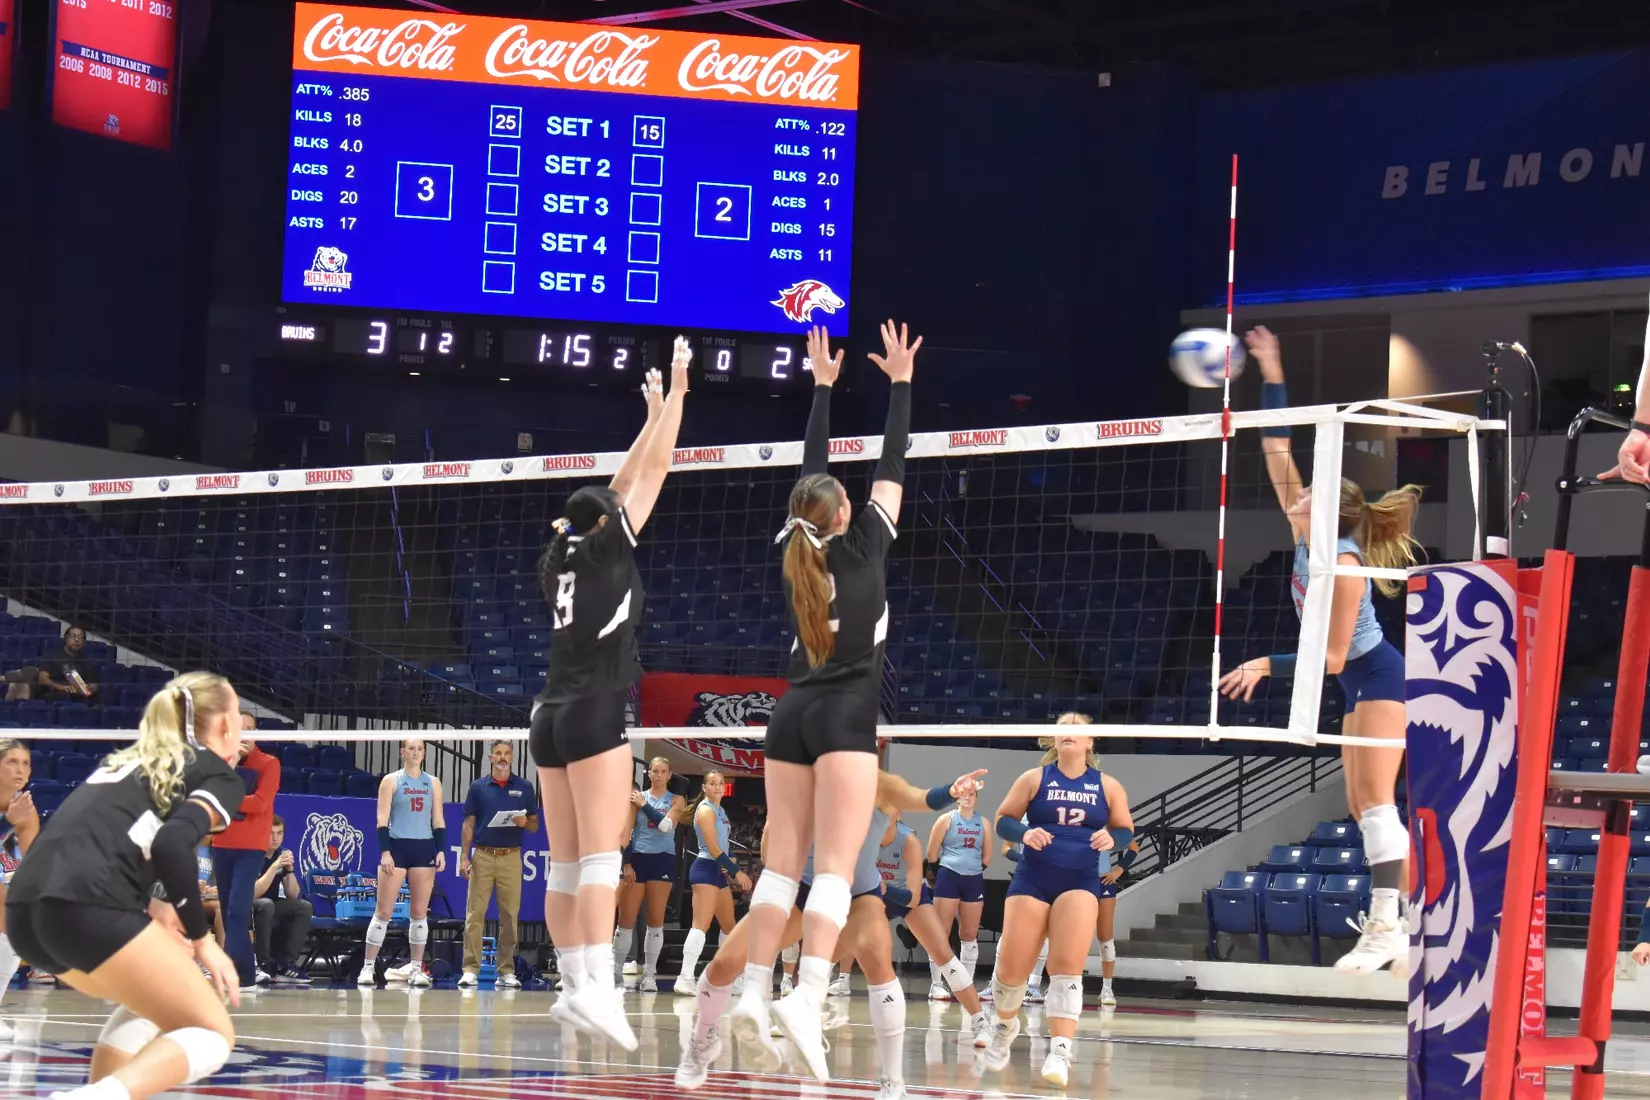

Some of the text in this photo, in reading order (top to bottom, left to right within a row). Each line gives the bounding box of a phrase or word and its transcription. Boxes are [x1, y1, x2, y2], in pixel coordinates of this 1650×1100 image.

[63, 0, 87, 9] 15
[149, 2, 173, 20] 2012
[303, 13, 466, 72] Coca-Cola
[80, 47, 152, 75] NCAA TOURNAMENT
[484, 24, 660, 88] Coca-Cola
[60, 55, 169, 96] 2006 2008 2012 2015
[677, 39, 850, 102] Coca-Cola
[296, 84, 369, 102] ATT% .385
[296, 110, 361, 126] KILLS 18
[496, 114, 516, 130] 25
[547, 116, 609, 138] SET 1
[641, 125, 659, 140] 15
[775, 118, 845, 136] ATT% .122
[294, 137, 362, 152] BLKS 4.0
[775, 144, 835, 160] KILLS 11
[292, 163, 354, 178] ACES 2
[545, 155, 610, 177] SET 2
[1381, 142, 1645, 199] BELMON
[774, 170, 838, 186] BLKS 2.0
[292, 190, 357, 204] DIGS 20
[418, 177, 434, 201] 3
[543, 194, 608, 215] SET 3
[715, 197, 732, 221] 2
[772, 196, 829, 210] ACES 1
[290, 216, 356, 229] ASTS 17
[771, 222, 834, 236] DIGS 15
[541, 233, 606, 254] SET 4
[770, 248, 831, 261] ASTS 11
[540, 271, 605, 293] SET 5
[282, 325, 315, 340] BRUINS
[367, 321, 387, 354] 3
[420, 333, 426, 350] 1
[438, 333, 453, 354] 2
[539, 334, 591, 367] 1:15
[613, 349, 628, 369] 2
[716, 350, 731, 371] 0
[771, 347, 792, 379] 2
[1097, 419, 1163, 438] BRUINS
[828, 438, 864, 455] UINS
[949, 429, 1008, 447] BELMONT
[543, 455, 597, 471] BRUINS
[672, 447, 725, 464] BELMONT
[305, 469, 353, 484] BRUINS
[423, 463, 471, 479] BELMONT
[89, 481, 133, 496] BRUINS
[196, 475, 240, 490] BELMONT
[410, 797, 424, 812] 15
[1046, 789, 1098, 806] BELMONT
[1056, 806, 1086, 827] 12
[963, 837, 976, 848] 12
